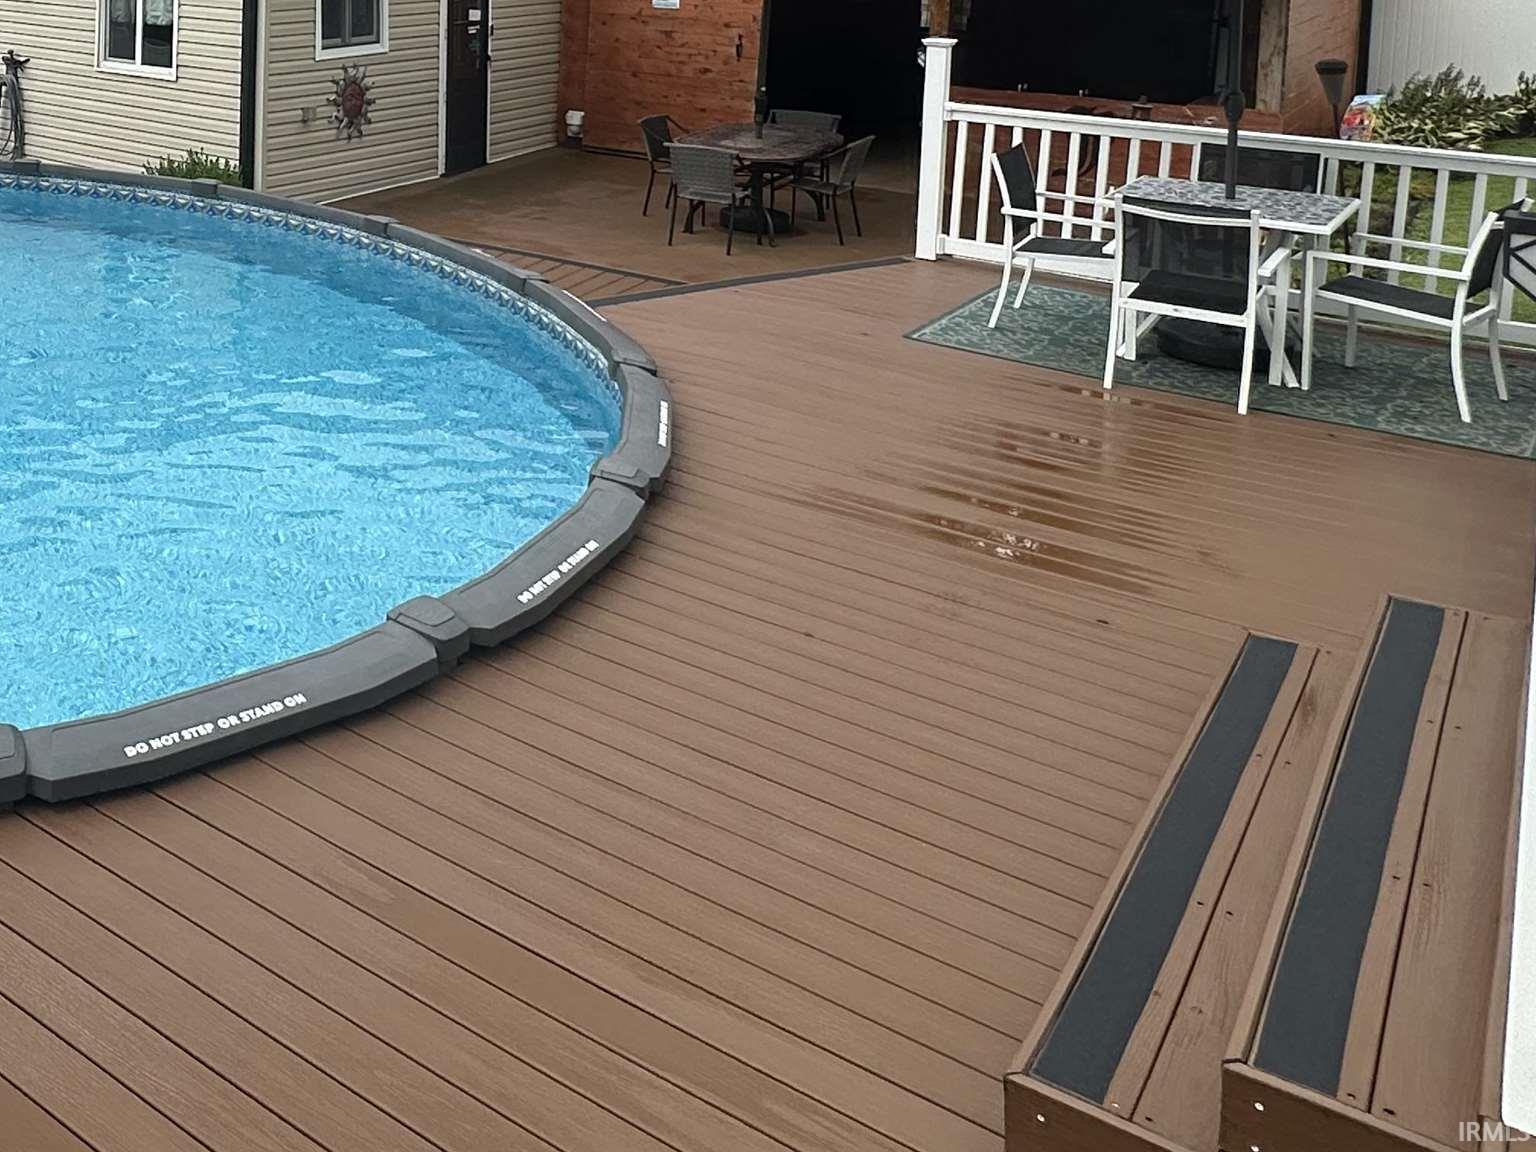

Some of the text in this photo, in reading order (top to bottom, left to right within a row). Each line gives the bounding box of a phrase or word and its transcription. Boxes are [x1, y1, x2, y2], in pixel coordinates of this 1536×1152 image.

[123, 693, 307, 757] DO NOT STEP OR STAND ON
